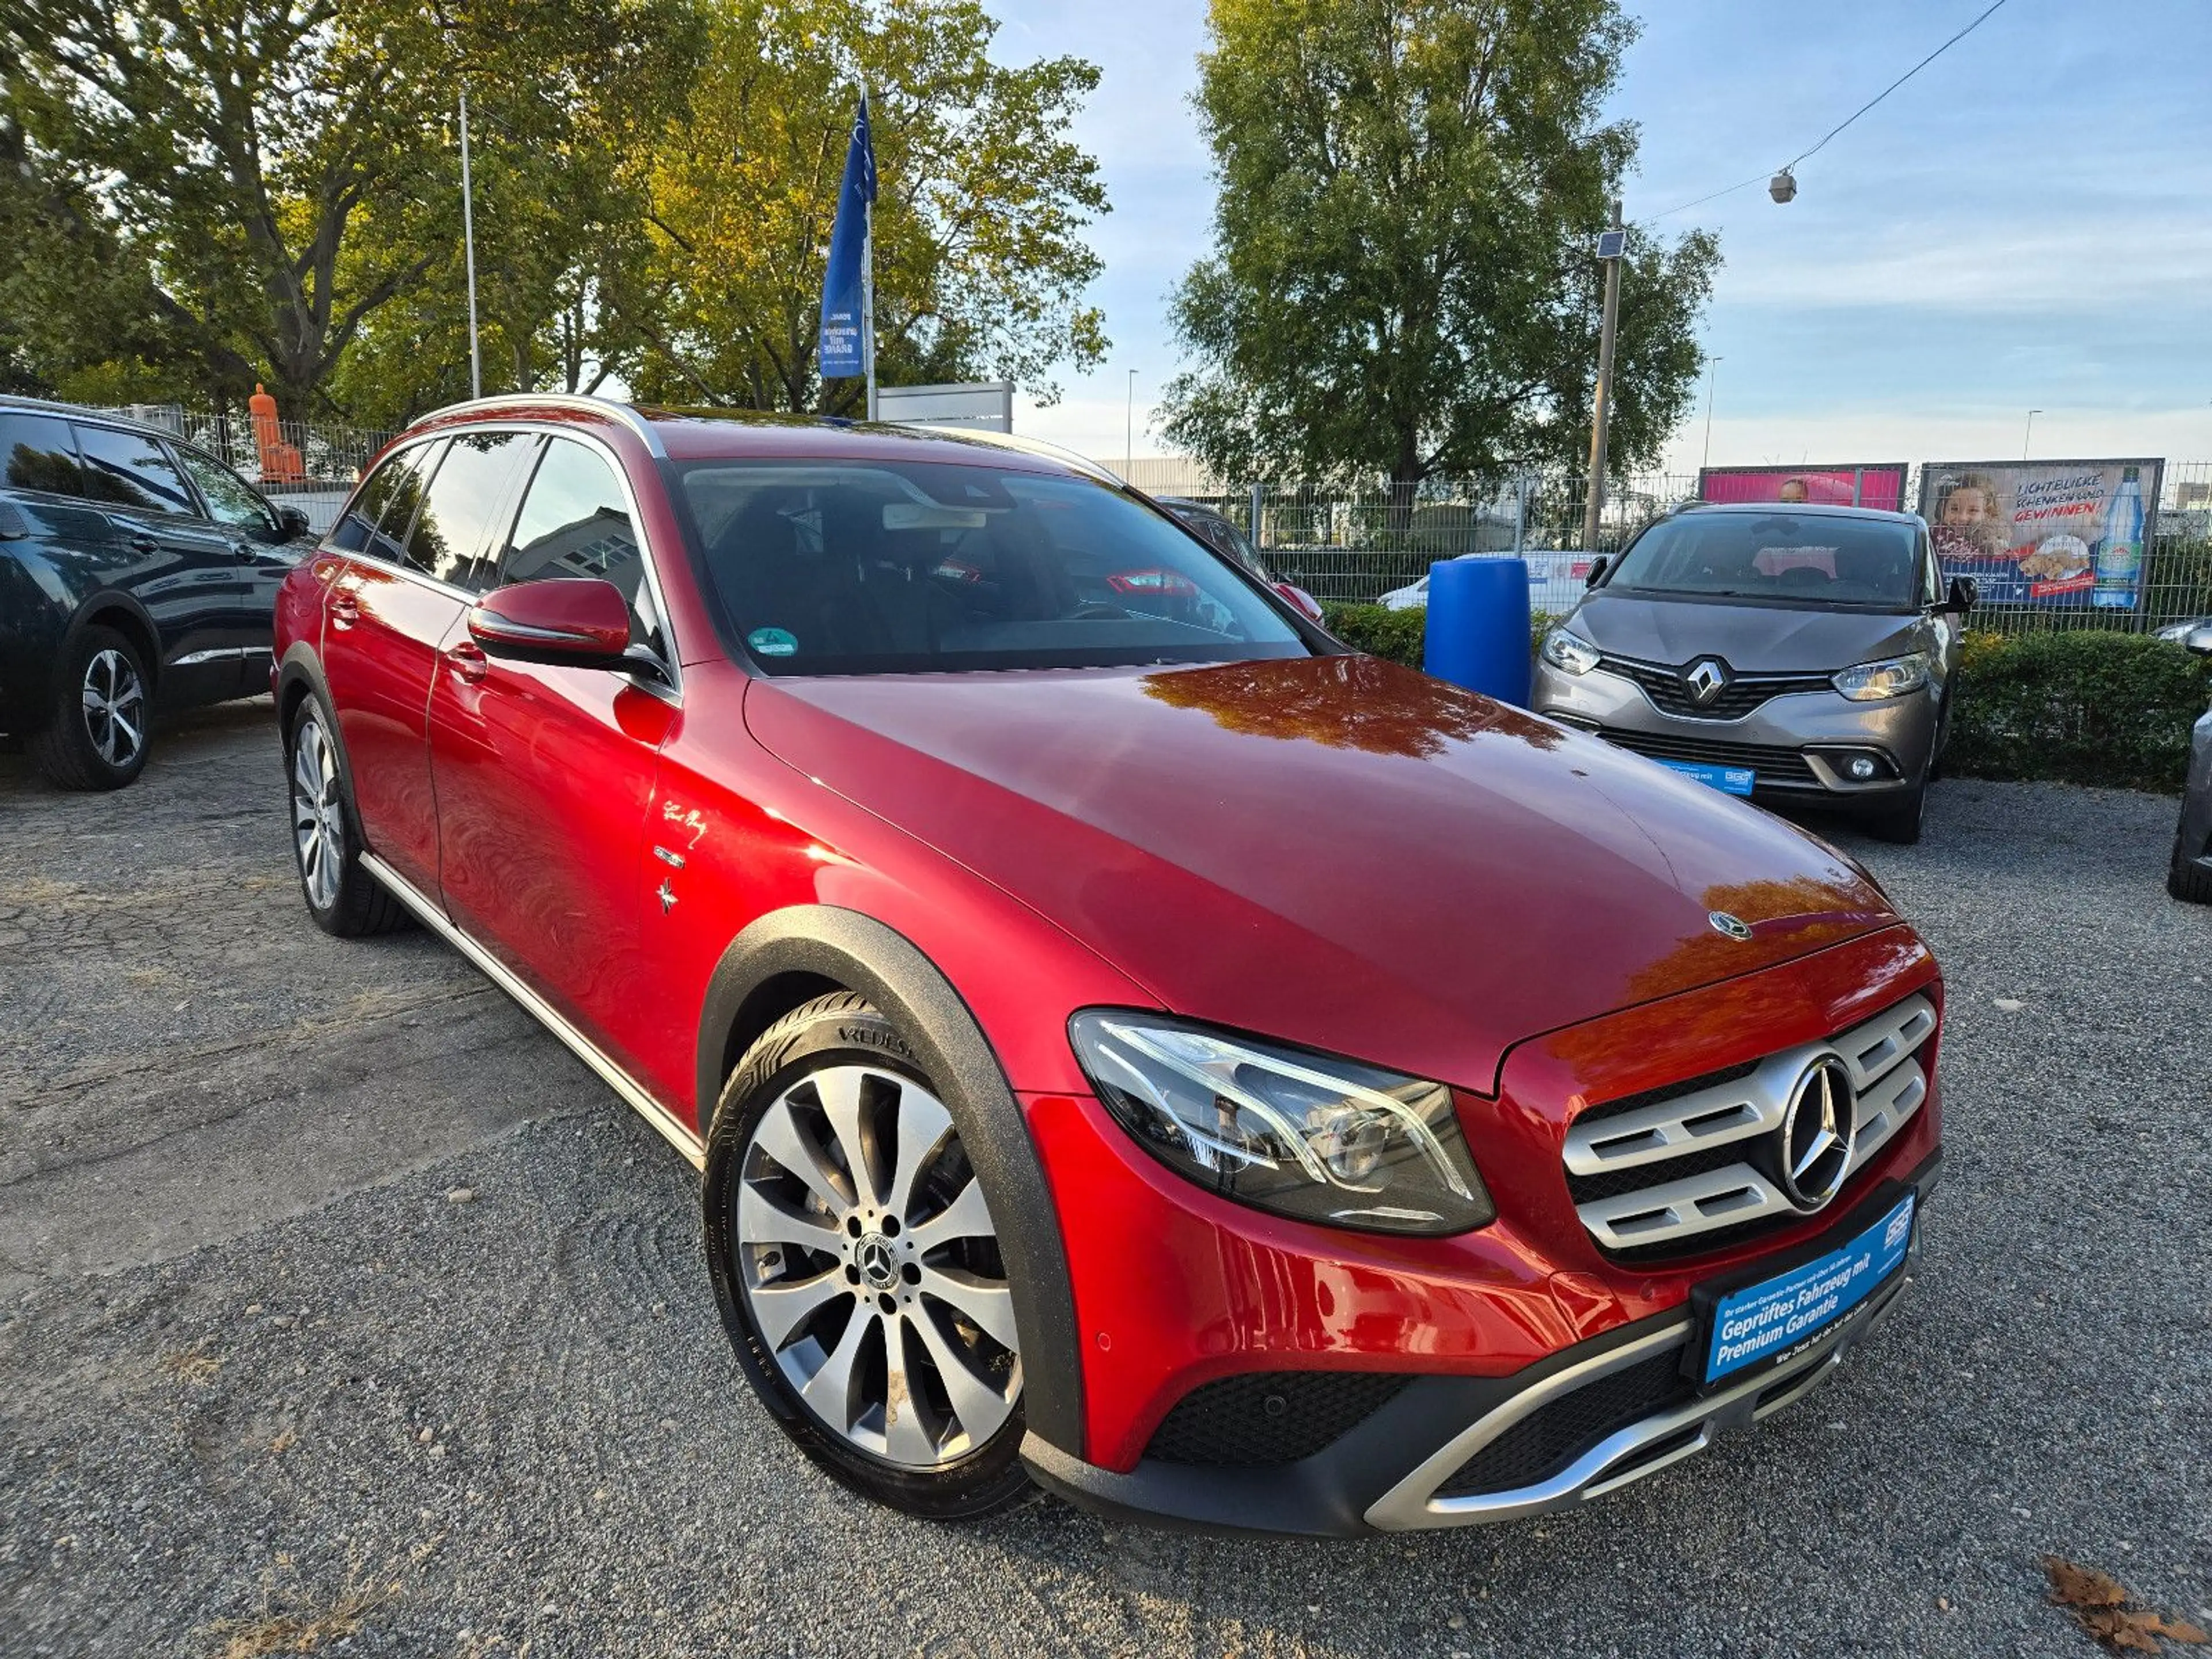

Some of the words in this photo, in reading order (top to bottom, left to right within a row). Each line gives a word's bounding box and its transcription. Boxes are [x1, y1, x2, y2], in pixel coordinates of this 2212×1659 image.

[2015, 502, 2103, 522] GEWINNEN!
[1717, 1325, 1784, 1366] Premium
[1786, 1294, 1839, 1334] Garantie
[1722, 1299, 1796, 1340] Geprüftes
[1796, 1267, 1852, 1309] Fahrzeug
[1852, 1252, 1870, 1277] mit
